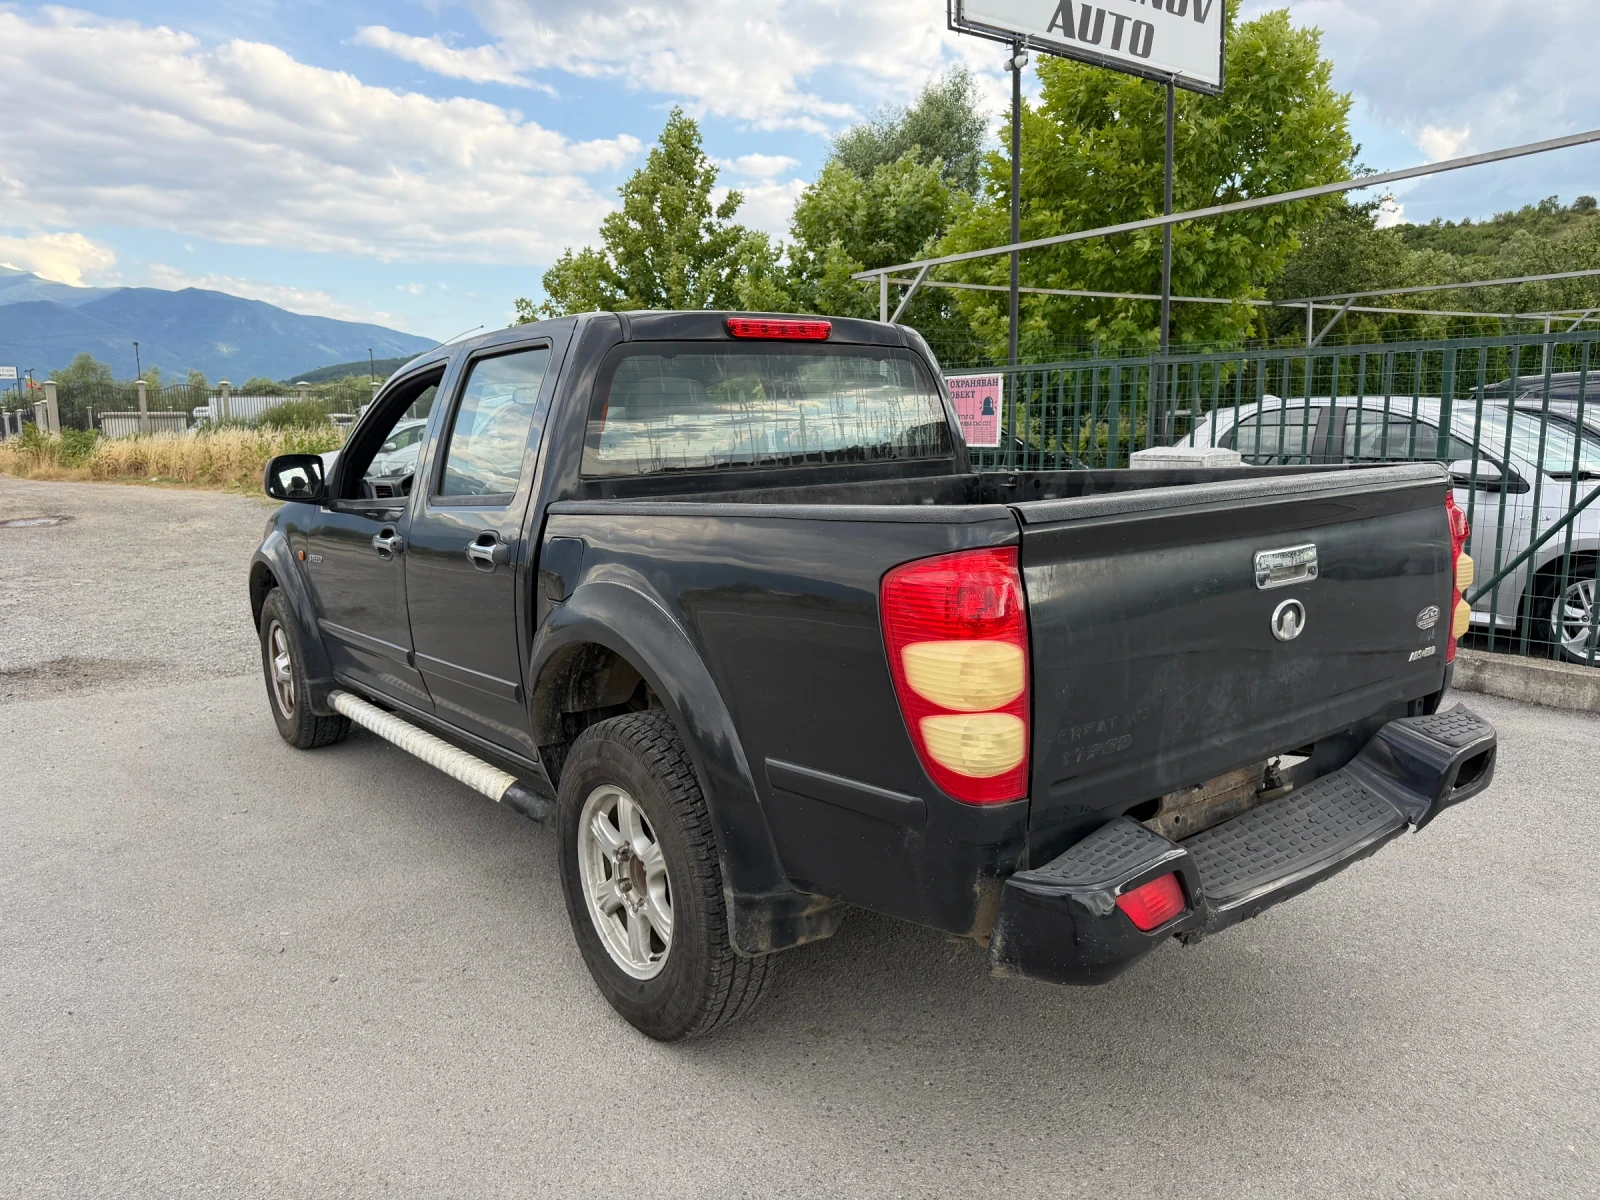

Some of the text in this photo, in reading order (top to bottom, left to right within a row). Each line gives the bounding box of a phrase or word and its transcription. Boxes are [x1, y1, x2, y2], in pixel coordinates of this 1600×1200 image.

[1046, 0, 1154, 58] AUTO
[950, 378, 998, 388] ОХРАНЯВАН
[950, 390, 975, 399] ОБЕКТ
